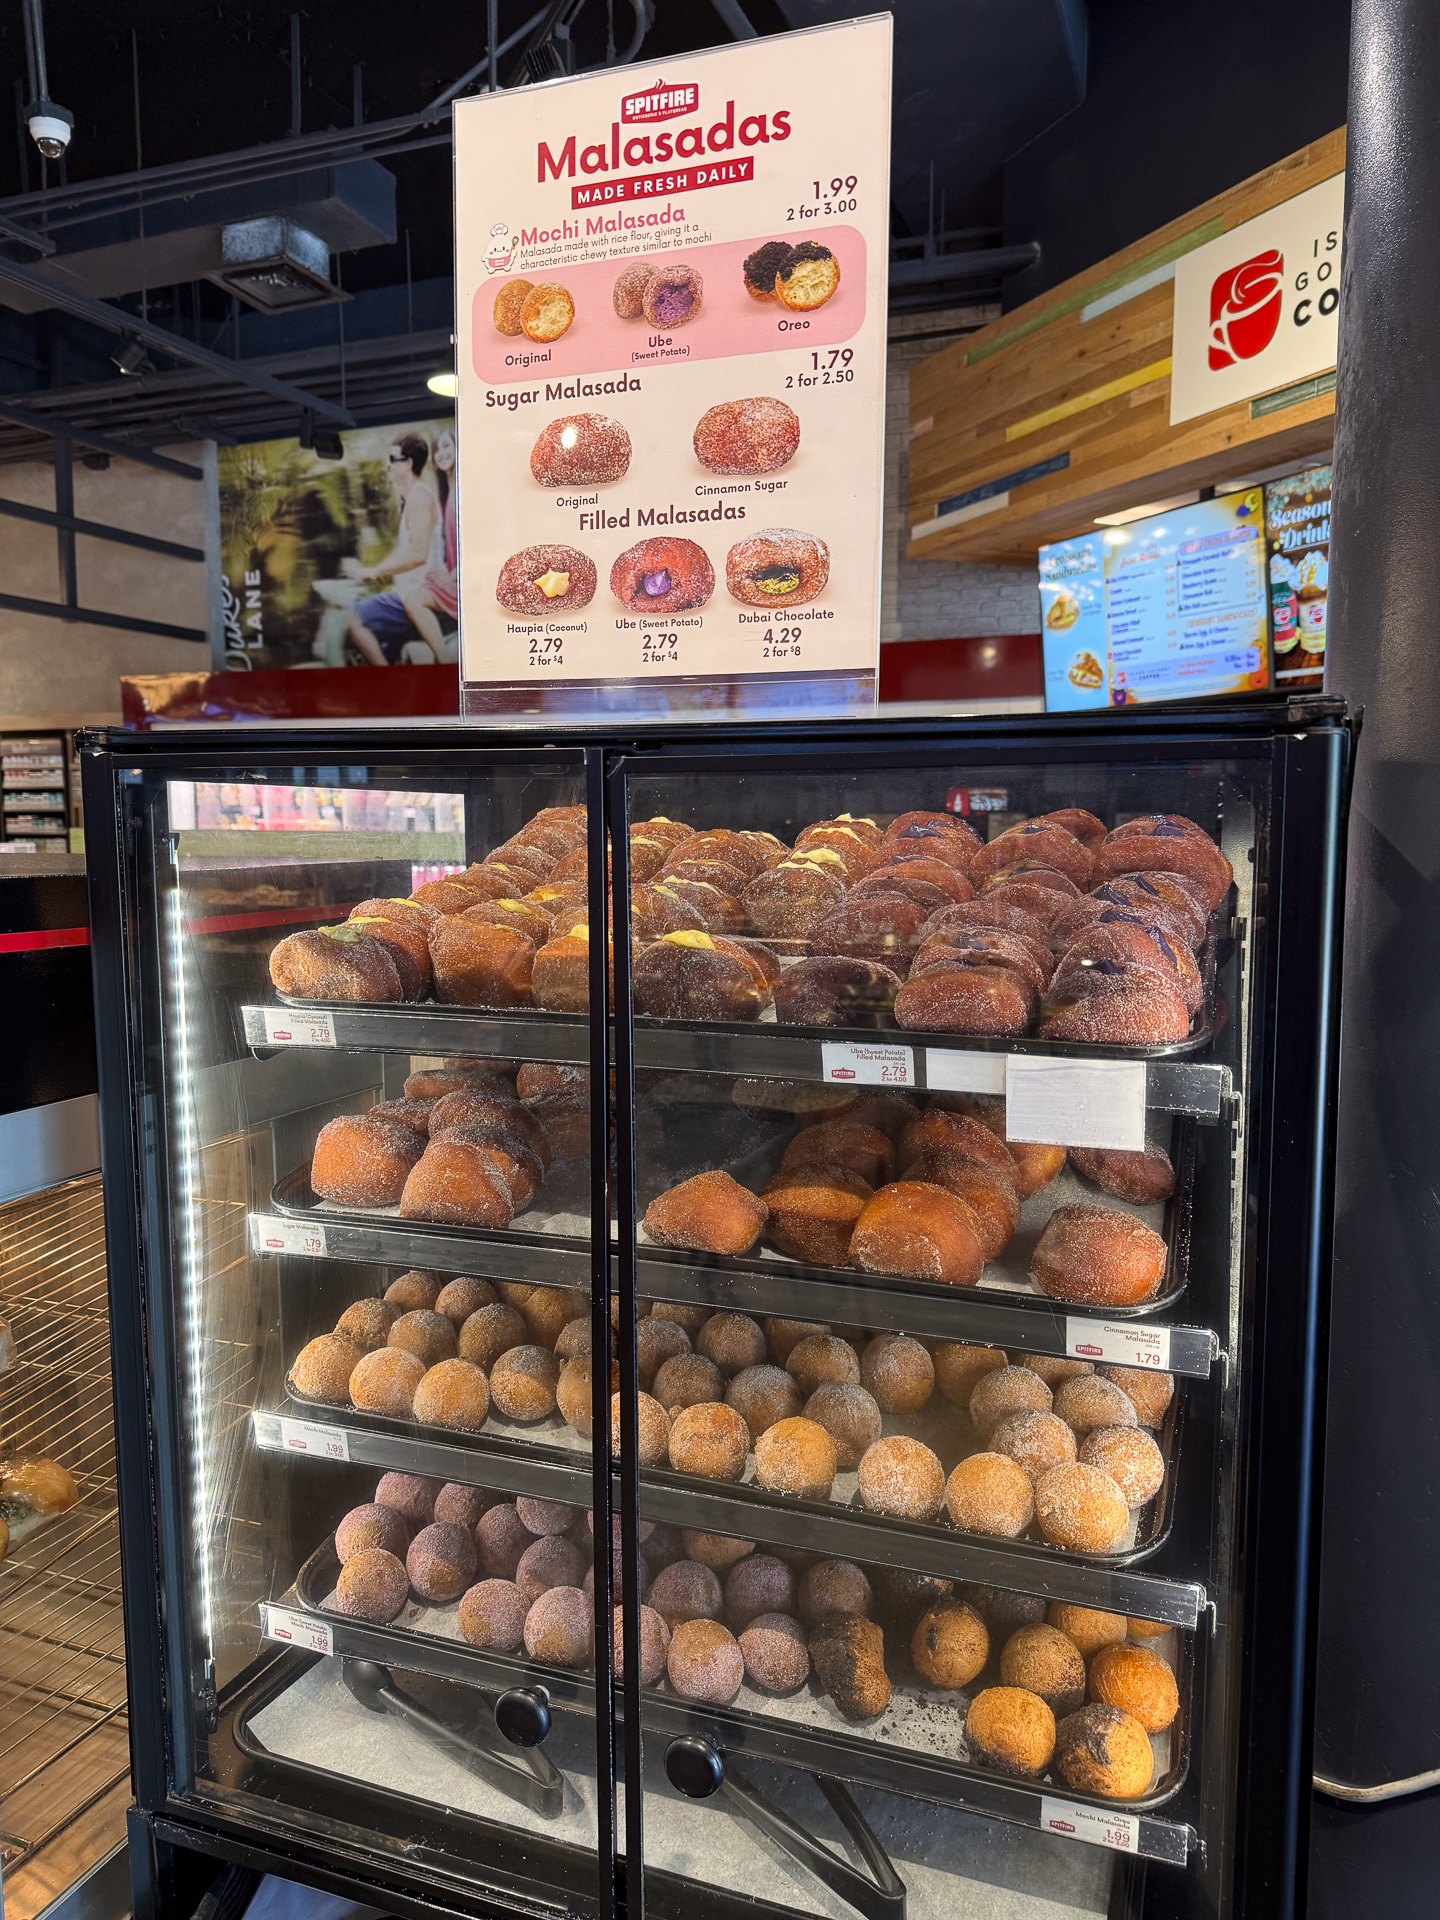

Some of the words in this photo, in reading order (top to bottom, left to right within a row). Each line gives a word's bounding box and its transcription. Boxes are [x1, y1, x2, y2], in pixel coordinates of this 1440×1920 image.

[626, 88, 694, 115] SPITFIRE
[537, 100, 792, 183] Malasadas
[577, 184, 624, 204] MADE
[633, 174, 688, 195] FRESH
[696, 162, 749, 184] DAILY
[813, 175, 858, 199] 1.99
[786, 208, 795, 222] 2
[798, 204, 820, 220] for
[824, 199, 857, 215] 3.00
[521, 220, 579, 246] Mochi
[586, 203, 685, 235] Malasada
[520, 245, 562, 258] Malasada
[565, 240, 588, 251] made
[591, 236, 609, 247] with
[612, 235, 628, 244] rice
[630, 231, 652, 241] flour,
[655, 226, 681, 240] giving
[684, 224, 690, 233] it
[1314, 231, 1337, 258] IS
[520, 254, 578, 270] characteristic
[580, 250, 607, 261] chewy
[609, 244, 640, 256] texture
[643, 240, 671, 252] similar
[673, 238, 683, 247] to
[685, 232, 712, 245] mochi
[1295, 262, 1332, 291] GO
[777, 318, 810, 332] Oreo
[505, 349, 552, 367] Original
[648, 335, 673, 349] Ube
[631, 346, 657, 363] (Sweet
[660, 344, 690, 361] Potato)
[810, 349, 854, 371] 1.79
[785, 376, 794, 389] 2
[797, 372, 819, 388] for
[822, 369, 854, 385] 2.50
[485, 387, 540, 411] Sugar
[545, 374, 642, 401] Malasada
[695, 483, 751, 496] Cinnamon
[754, 478, 788, 493] Sugar
[556, 494, 599, 509] Original
[579, 508, 630, 531] Filled
[636, 501, 746, 526] Malasadas
[244, 569, 264, 649] LANE
[738, 610, 771, 624] Dubai
[774, 609, 834, 622] Chocolate
[507, 623, 543, 635] Haupia
[545, 621, 588, 634] (Coconut)
[615, 618, 636, 630] Ube
[638, 618, 668, 630] (Sweet
[670, 616, 703, 629] Potato)
[642, 633, 678, 649] 2.79
[763, 628, 802, 644] 4.29
[529, 638, 563, 654] 2.79
[763, 648, 770, 657] 2
[771, 646, 788, 657] for
[791, 646, 801, 656] $8
[529, 657, 535, 666] 2
[537, 655, 552, 666] for
[553, 655, 563, 666] $4
[642, 652, 648, 662] 2
[651, 651, 666, 662] for
[668, 651, 678, 661] $4
[311, 1029, 329, 1037] 2.79
[882, 1066, 906, 1076] 2.79
[305, 1239, 321, 1248] 1.79
[1104, 1326, 1139, 1335] Cinnamon
[1140, 1331, 1160, 1339] Sugar
[1126, 1335, 1160, 1344] Malasada
[1076, 1346, 1101, 1354] SPITFIRE
[1136, 1352, 1160, 1365] 1.79
[327, 1443, 343, 1453] 1.99
[312, 1636, 328, 1647] 1.99
[1051, 1821, 1074, 1831] SPITFIRE
[1076, 1811, 1096, 1822] Mochi
[1097, 1817, 1130, 1829] Malasada
[1114, 1816, 1130, 1824] Oreo
[1106, 1829, 1130, 1842] 1.99
[1115, 1840, 1130, 1848] 3.00
